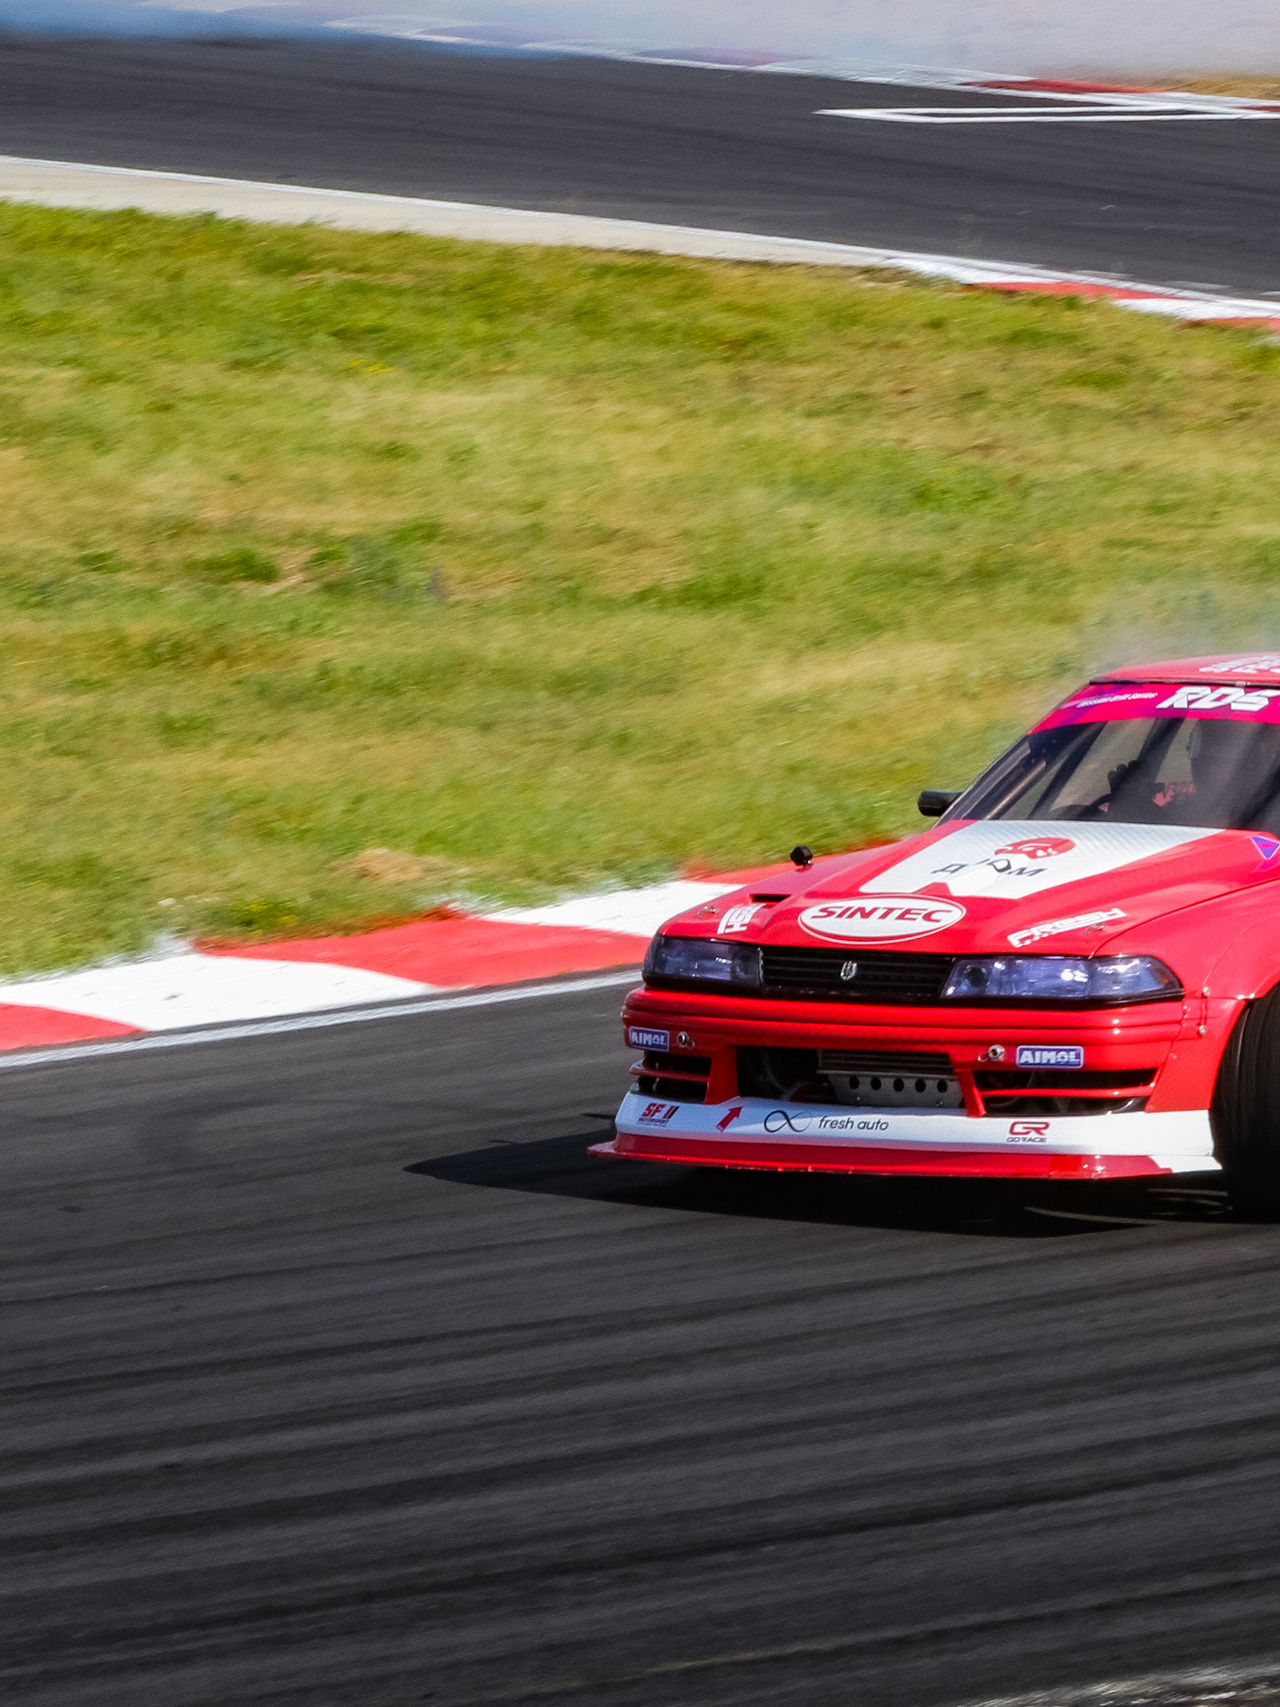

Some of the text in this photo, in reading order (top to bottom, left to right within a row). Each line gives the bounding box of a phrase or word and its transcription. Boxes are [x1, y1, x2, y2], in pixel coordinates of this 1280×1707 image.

[811, 905, 951, 923] SINTEC
[631, 1031, 668, 1046] AIMOL
[1019, 1050, 1080, 1065] AIMOL
[818, 1115, 889, 1131] fresh auto
